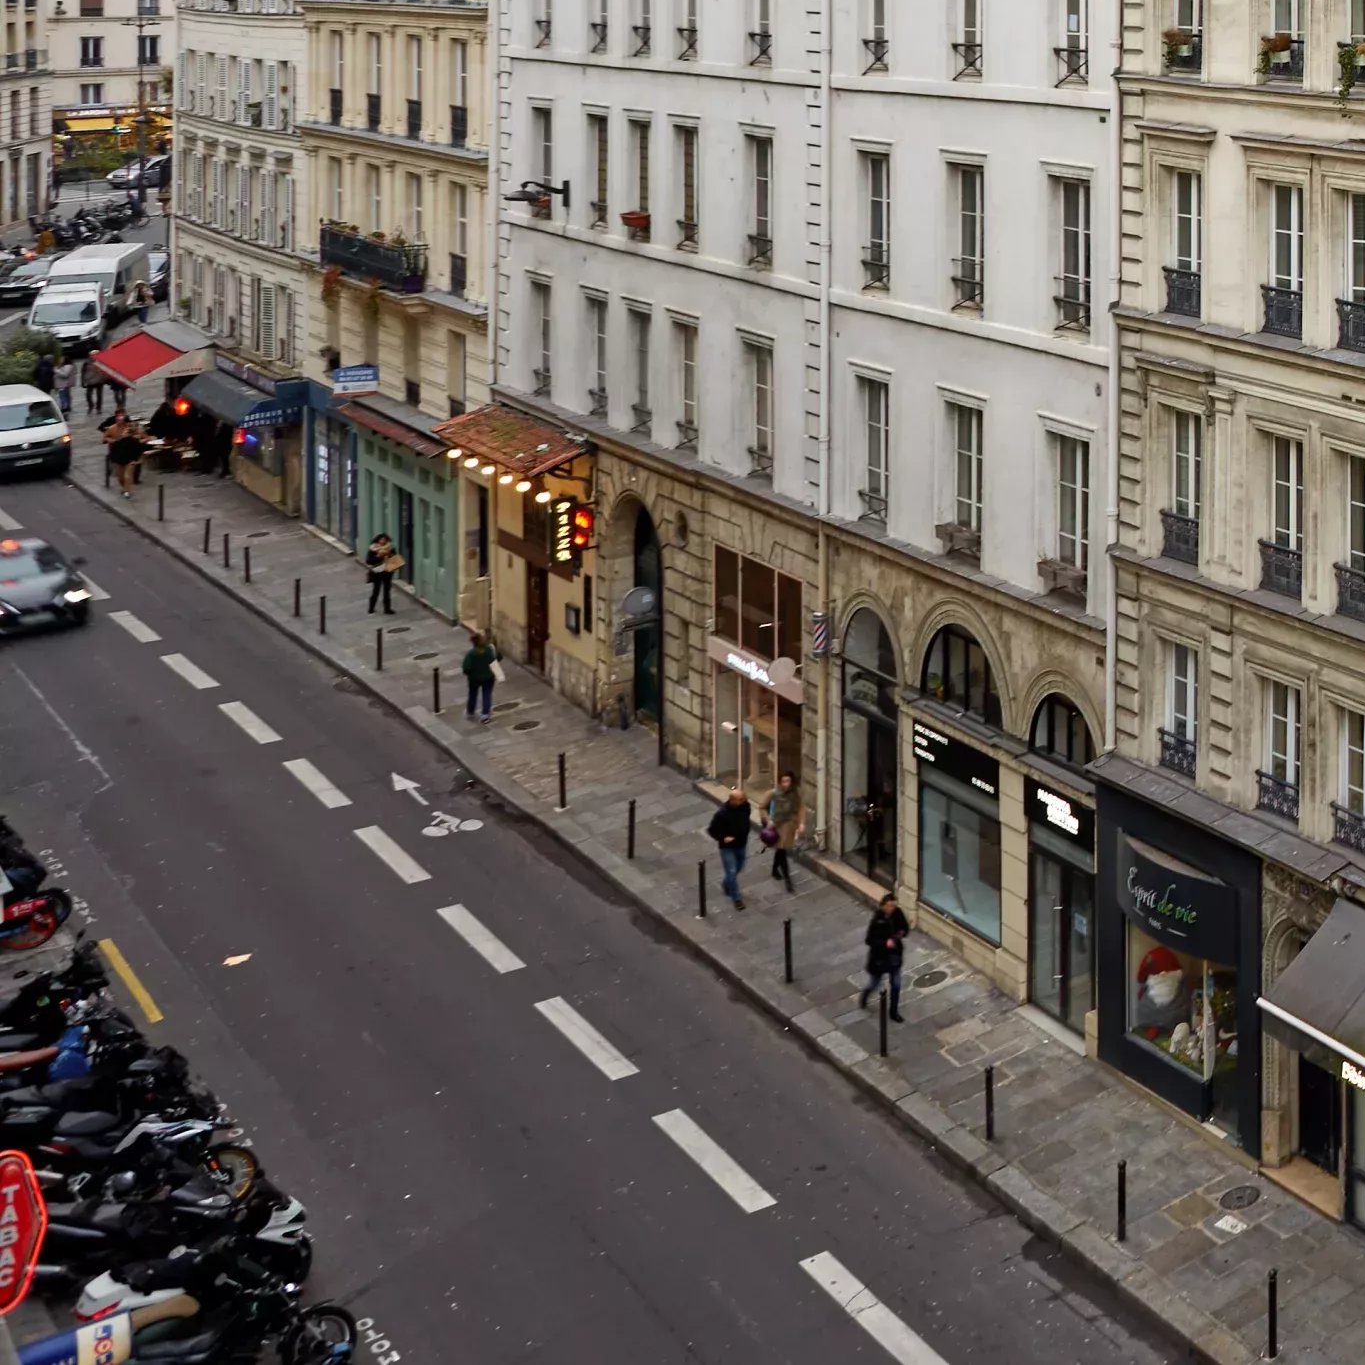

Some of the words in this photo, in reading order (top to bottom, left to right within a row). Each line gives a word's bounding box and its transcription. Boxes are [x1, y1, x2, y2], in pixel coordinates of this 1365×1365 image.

[1127, 866, 1157, 909] Esprit
[1157, 883, 1177, 916] de
[0, 1184, 21, 1287] TABAC
